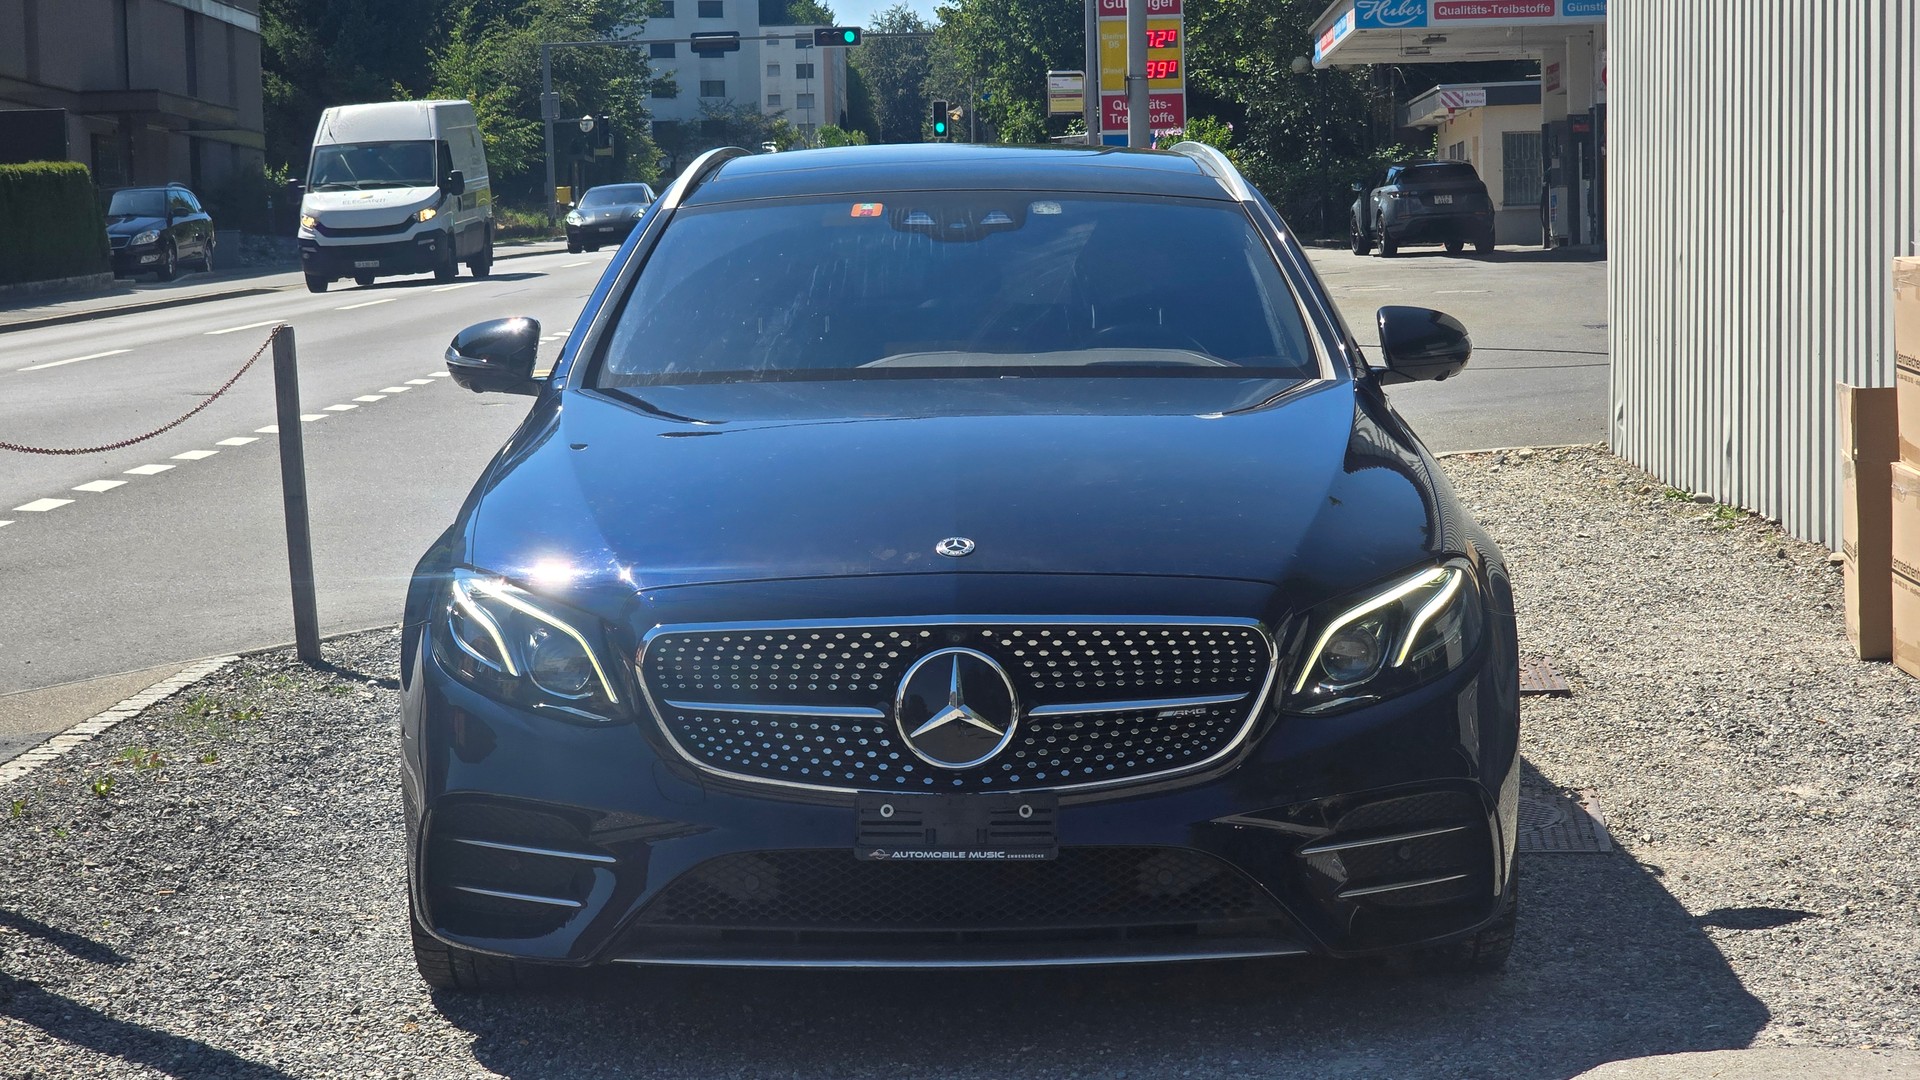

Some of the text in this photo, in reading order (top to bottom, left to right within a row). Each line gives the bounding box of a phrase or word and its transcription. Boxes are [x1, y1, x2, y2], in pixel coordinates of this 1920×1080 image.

[1356, 0, 1425, 26] Huber
[1438, 4, 1550, 16] Qualitäts-Treibstoffe
[1173, 707, 1207, 716] AMG
[891, 851, 966, 859] AUTOMOBILE
[968, 851, 1005, 859] MUSIC
